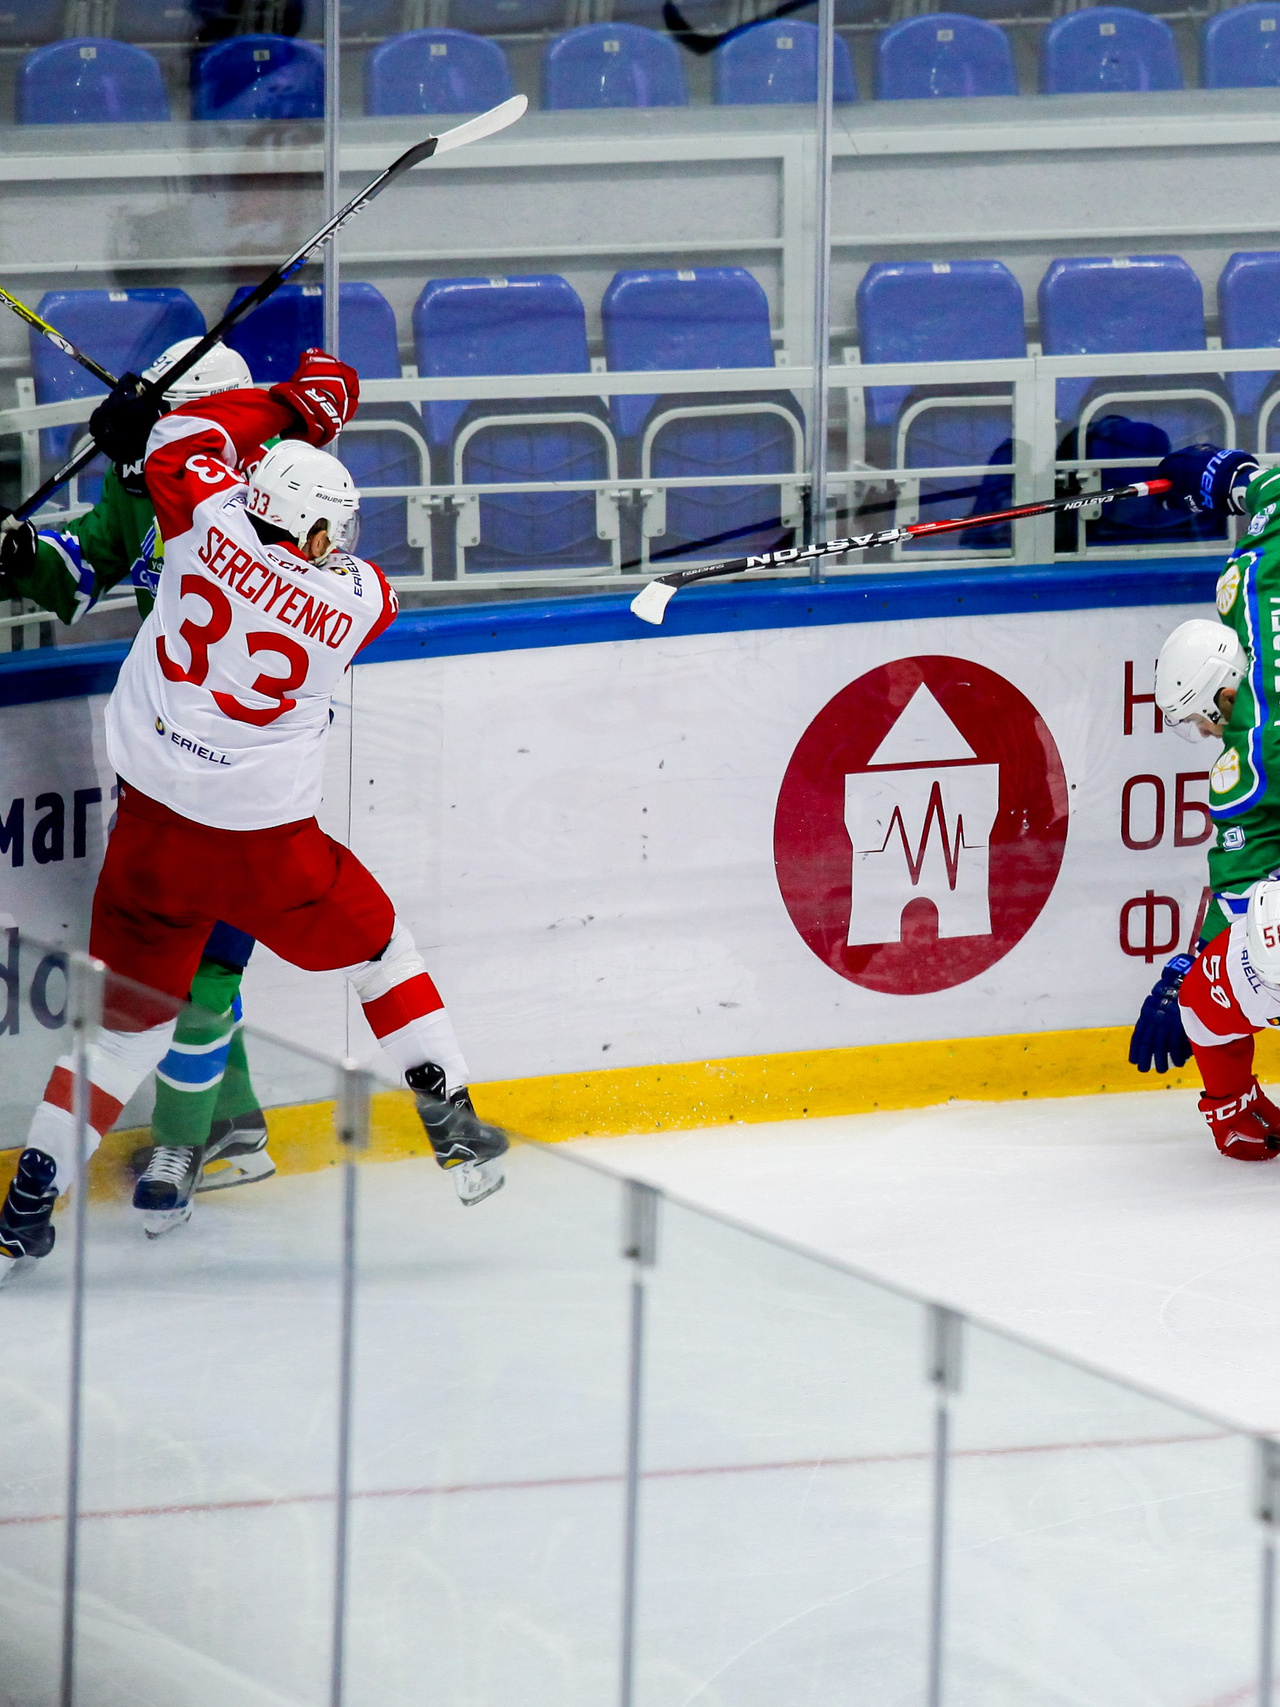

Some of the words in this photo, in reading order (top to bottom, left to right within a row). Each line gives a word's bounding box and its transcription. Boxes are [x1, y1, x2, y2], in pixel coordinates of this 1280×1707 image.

[303, 198, 372, 259] NEXUS
[304, 387, 343, 440] UER
[315, 492, 343, 504] BAUER
[1200, 449, 1244, 510] AUER
[249, 487, 271, 516] 33
[1063, 494, 1115, 511] EASTON
[267, 552, 309, 575] CCM
[746, 528, 901, 568] EASTON
[198, 526, 353, 649] SERGIYENKO
[341, 555, 363, 598] ERIELL
[156, 573, 309, 727] 33
[171, 732, 231, 766] ERIELL
[1241, 946, 1262, 995] RIELL
[1200, 1084, 1259, 1124] CCM
